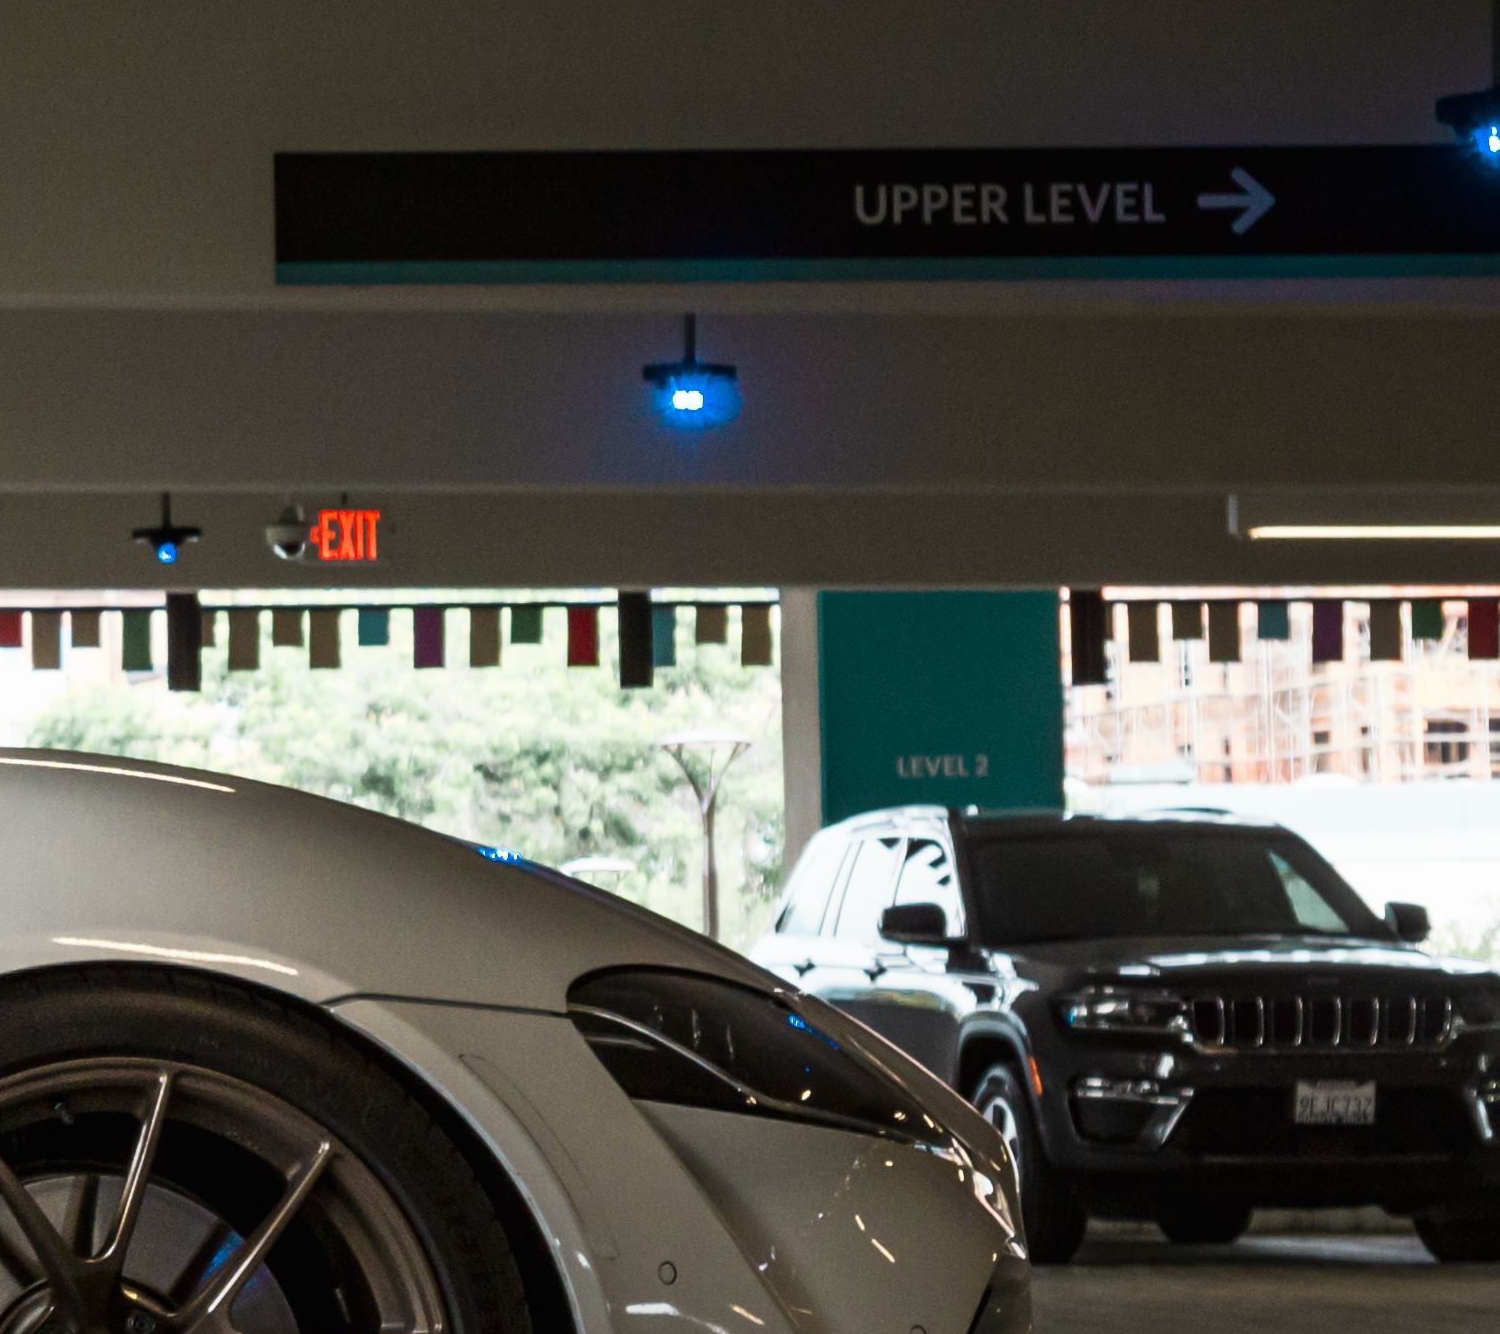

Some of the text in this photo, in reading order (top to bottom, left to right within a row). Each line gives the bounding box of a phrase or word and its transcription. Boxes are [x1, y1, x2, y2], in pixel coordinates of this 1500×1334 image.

[854, 181, 1167, 226] UPPER LEVEL
[318, 509, 380, 561] EXIT
[896, 753, 989, 779] LEVEL 2
